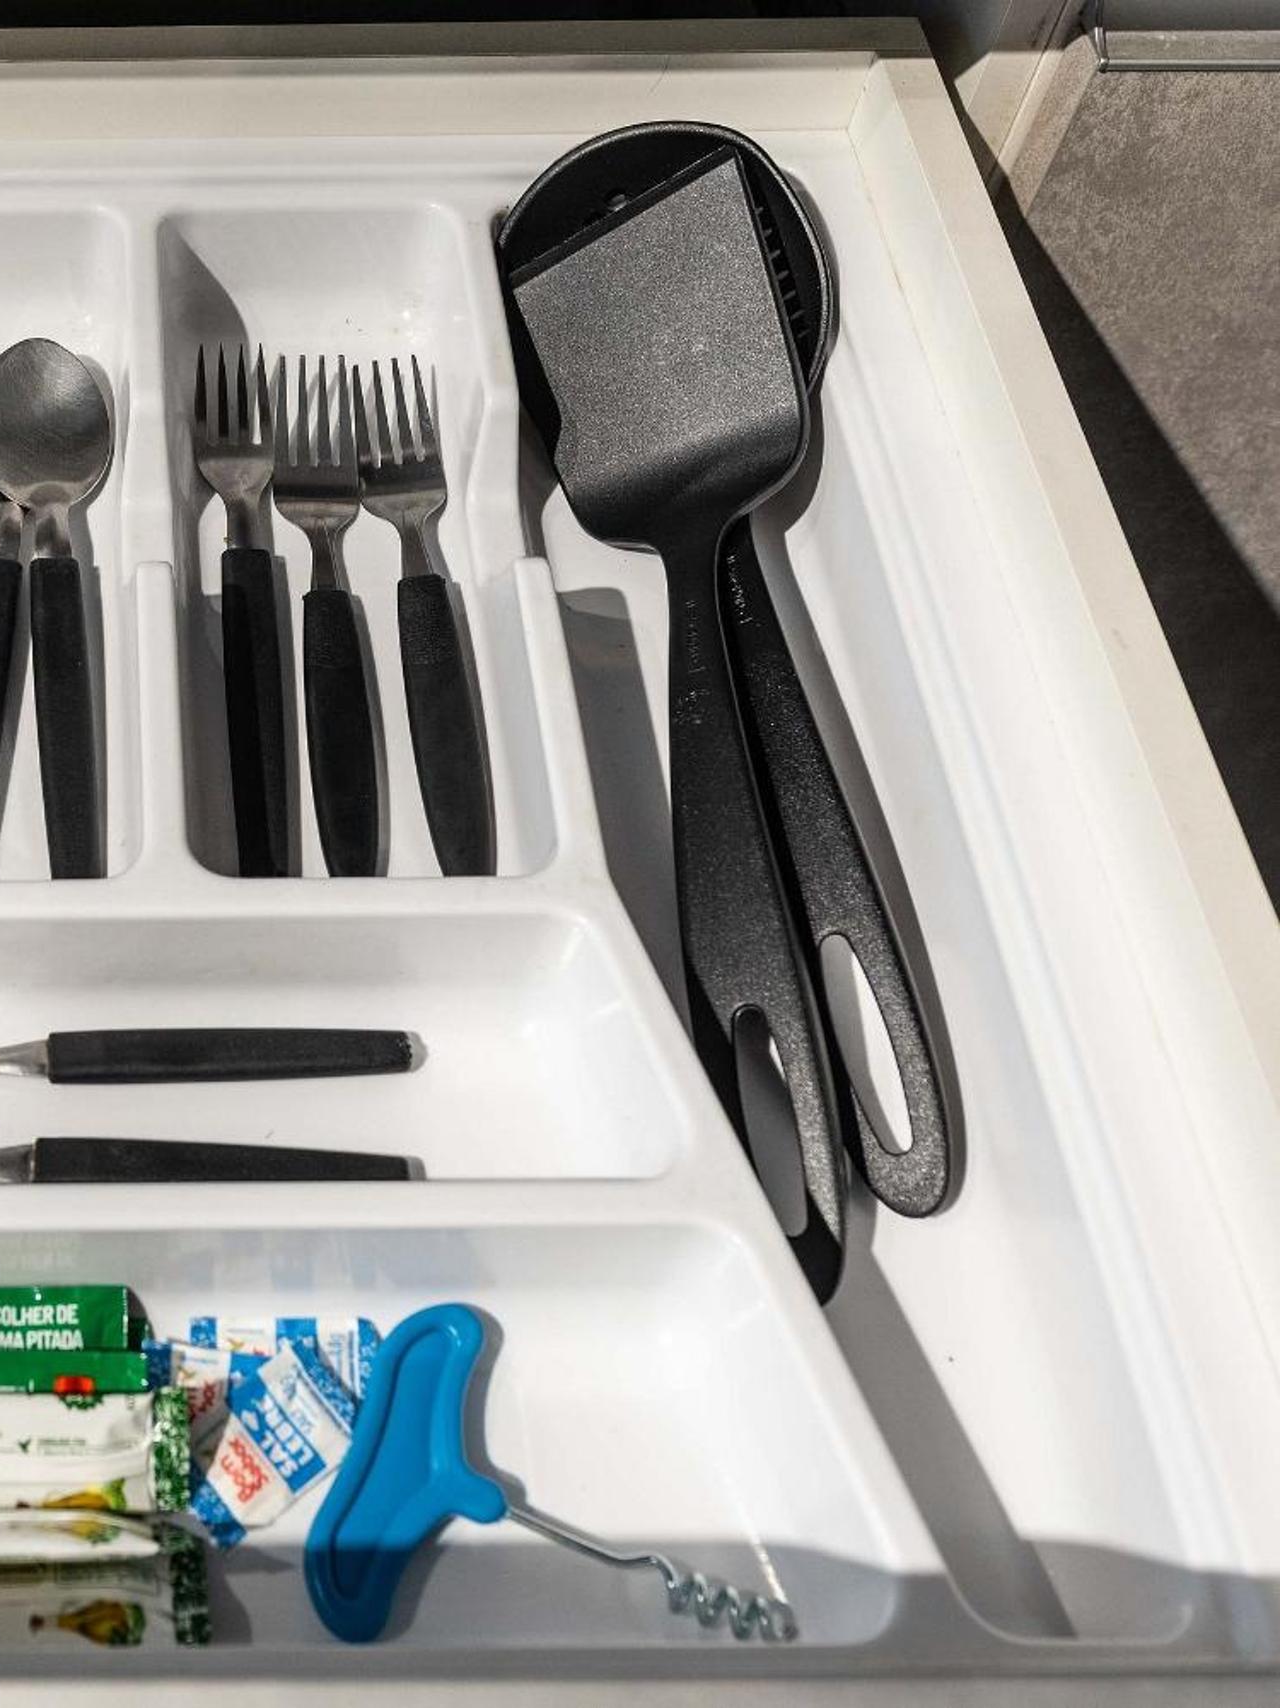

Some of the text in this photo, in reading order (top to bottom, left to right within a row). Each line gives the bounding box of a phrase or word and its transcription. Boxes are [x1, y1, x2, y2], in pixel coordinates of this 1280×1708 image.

[56, 1304, 80, 1325] DE
[26, 1329, 84, 1351] PITADA
[260, 1432, 300, 1477] SAL
